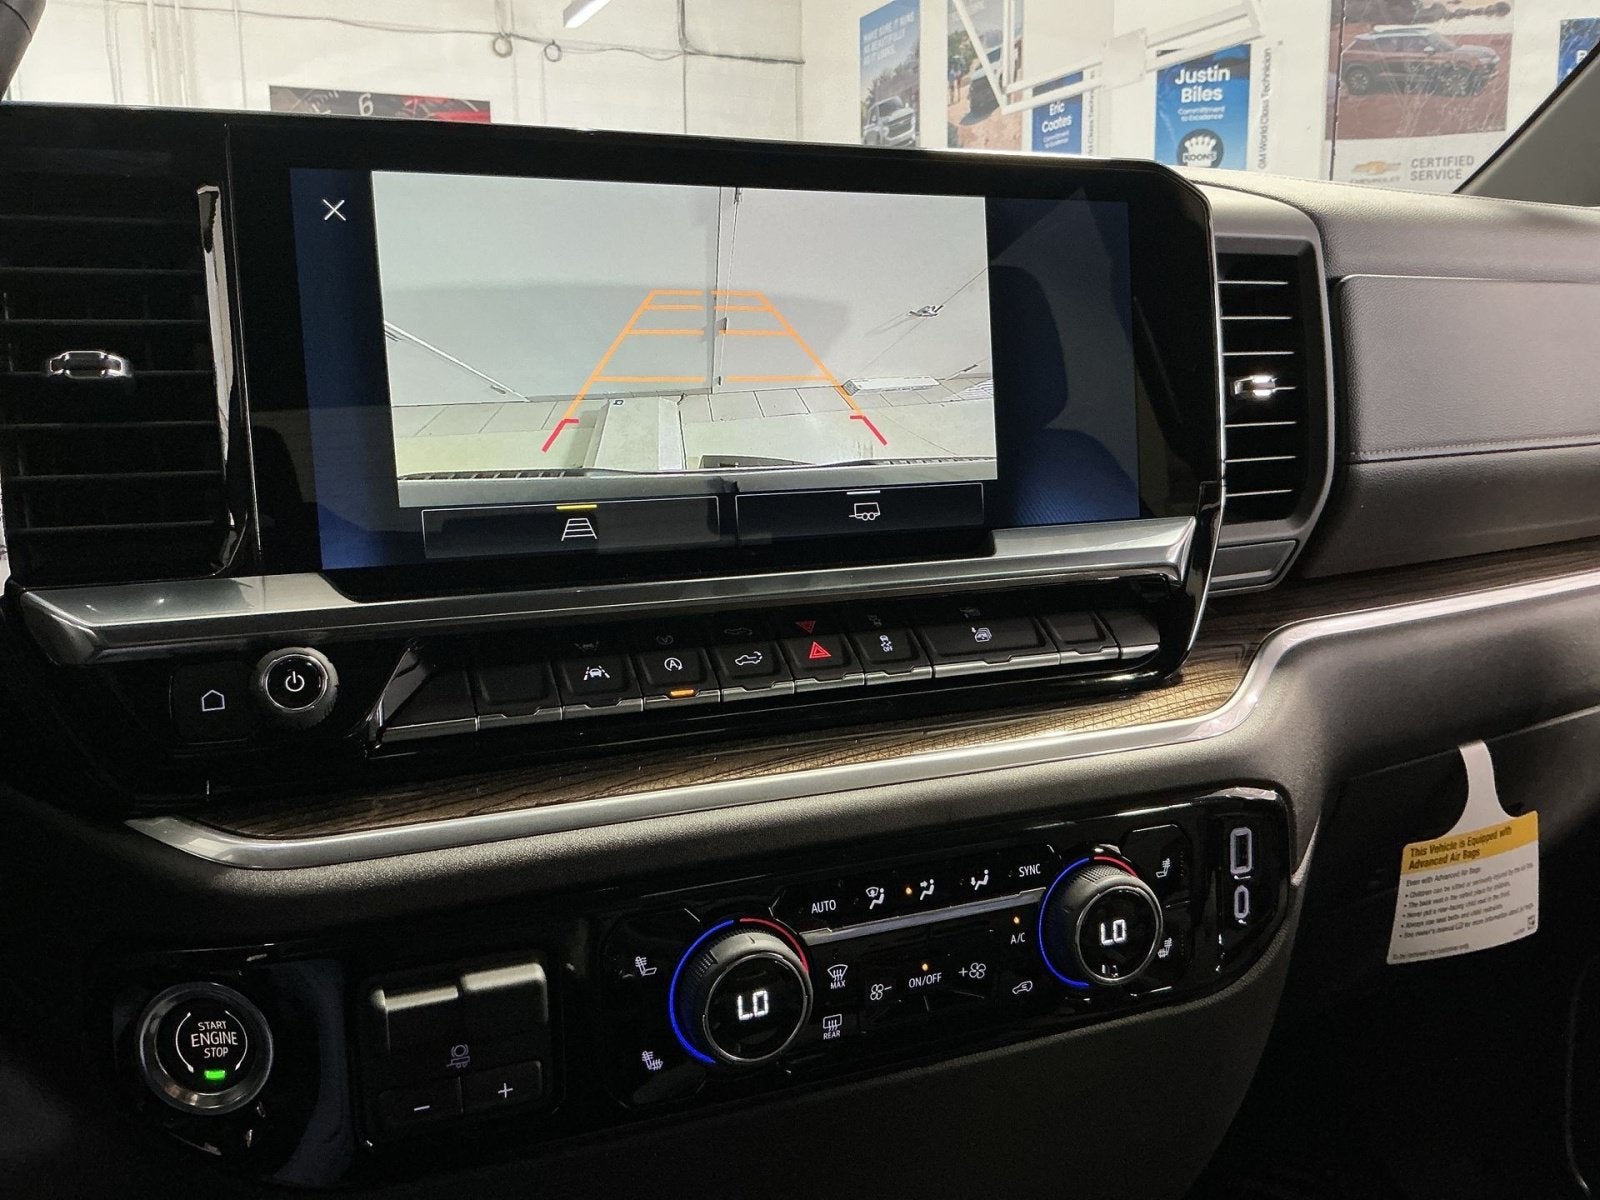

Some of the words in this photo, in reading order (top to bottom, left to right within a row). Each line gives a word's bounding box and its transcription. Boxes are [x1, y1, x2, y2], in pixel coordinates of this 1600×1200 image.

[1174, 64, 1231, 85] Justin
[1260, 47, 1272, 98] Technician
[1180, 85, 1223, 103] Biles
[357, 92, 374, 117] 6
[1049, 101, 1065, 116] Eric
[1259, 99, 1270, 125] Class
[1258, 126, 1269, 152] World
[1183, 152, 1217, 162] KOONS
[1410, 155, 1475, 169] CERTIFIED
[1410, 168, 1462, 181] SERVICE
[1410, 846, 1428, 858] This
[1429, 840, 1458, 854] Vehicle
[1459, 839, 1466, 848] is
[1467, 830, 1498, 846] Equipped
[1499, 825, 1513, 838] with
[1408, 853, 1449, 870] Advanced
[1450, 851, 1461, 862] Air
[1463, 848, 1481, 860] Bags
[1018, 863, 1041, 878] SYNC
[811, 900, 837, 914] AUTO
[1010, 932, 1026, 944] A/C
[829, 979, 846, 990] MAX
[908, 972, 943, 989] ON/OFF
[197, 1020, 227, 1032] START
[190, 1031, 239, 1048] ENGINE
[823, 1029, 841, 1040] REAR
[203, 1046, 229, 1059] STOP
